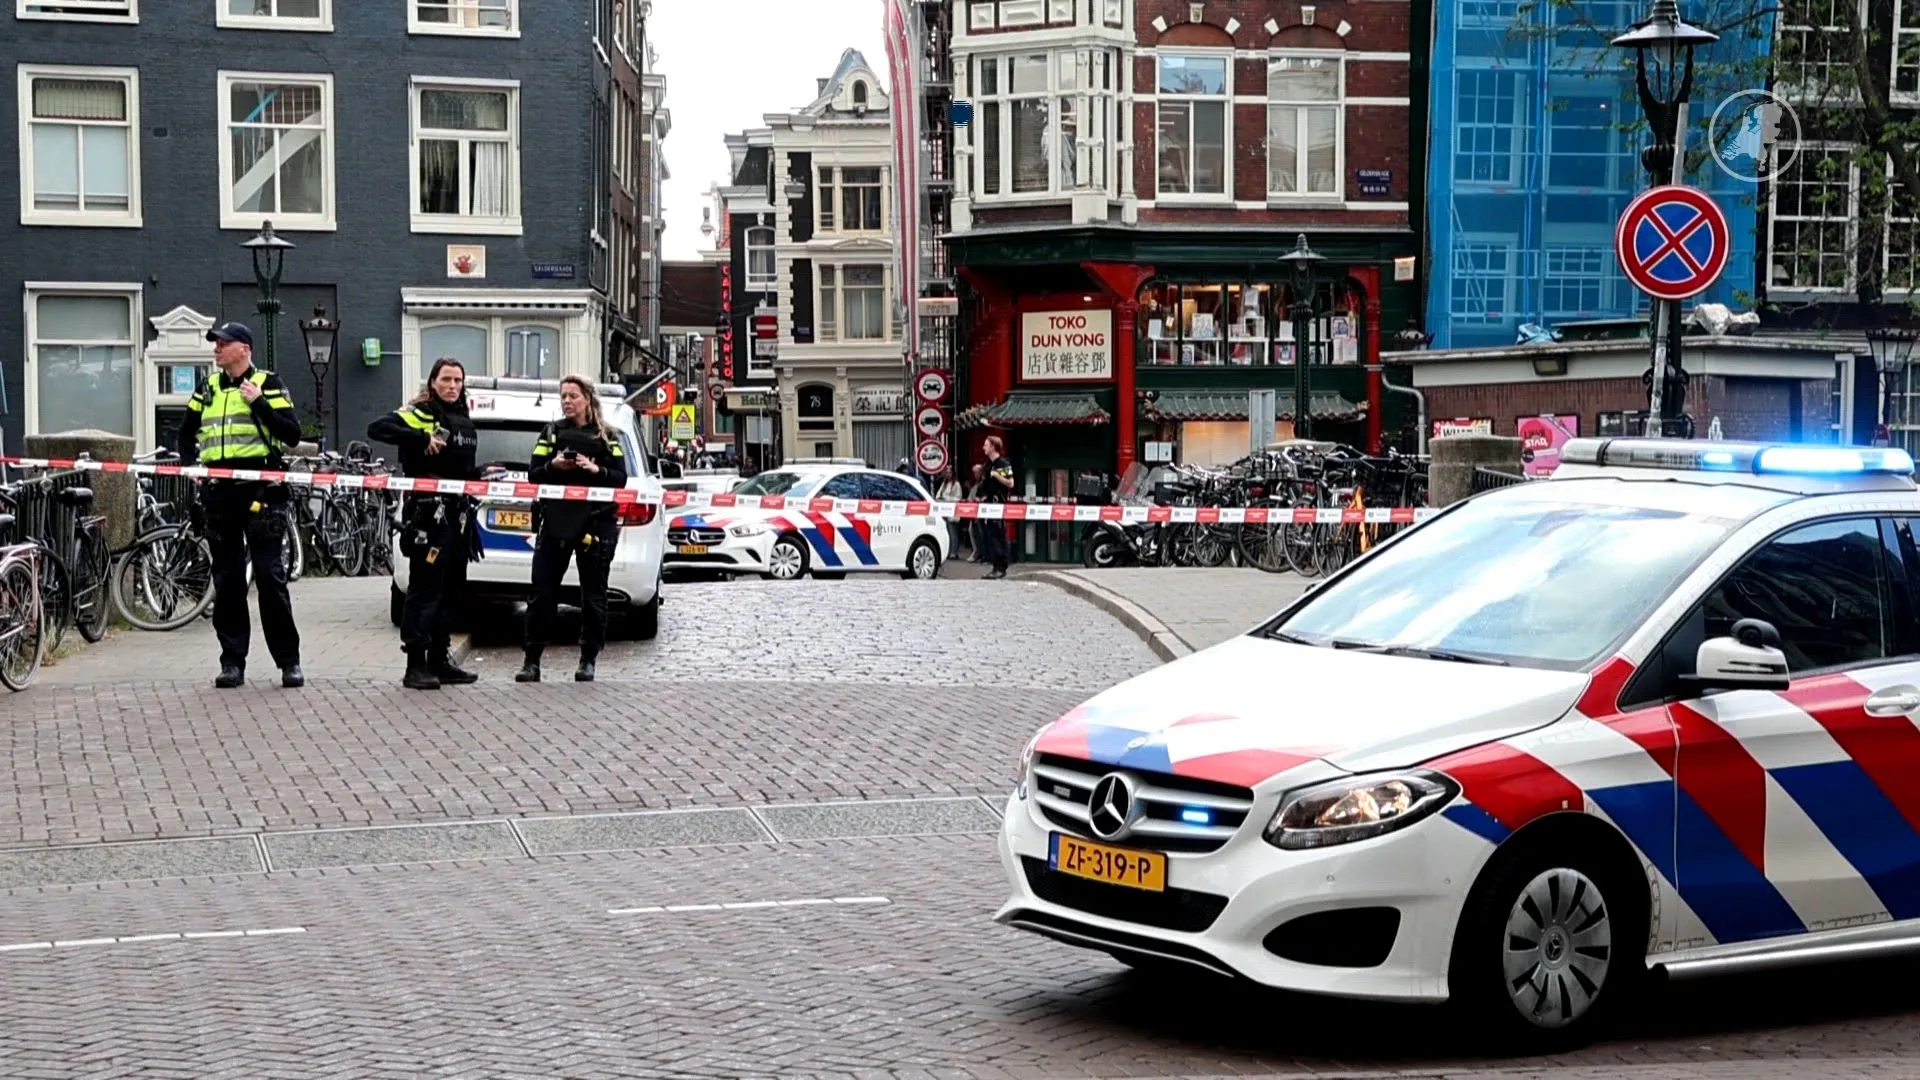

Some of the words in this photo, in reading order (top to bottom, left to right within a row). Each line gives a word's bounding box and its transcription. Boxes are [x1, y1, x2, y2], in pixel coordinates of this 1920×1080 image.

[1048, 316, 1087, 329] TOKO
[1031, 335, 1061, 347] DUN
[1065, 333, 1104, 347] YONG
[810, 395, 821, 408] 78
[499, 513, 530, 525] XT-5
[1066, 842, 1151, 884] ZF-319-P
